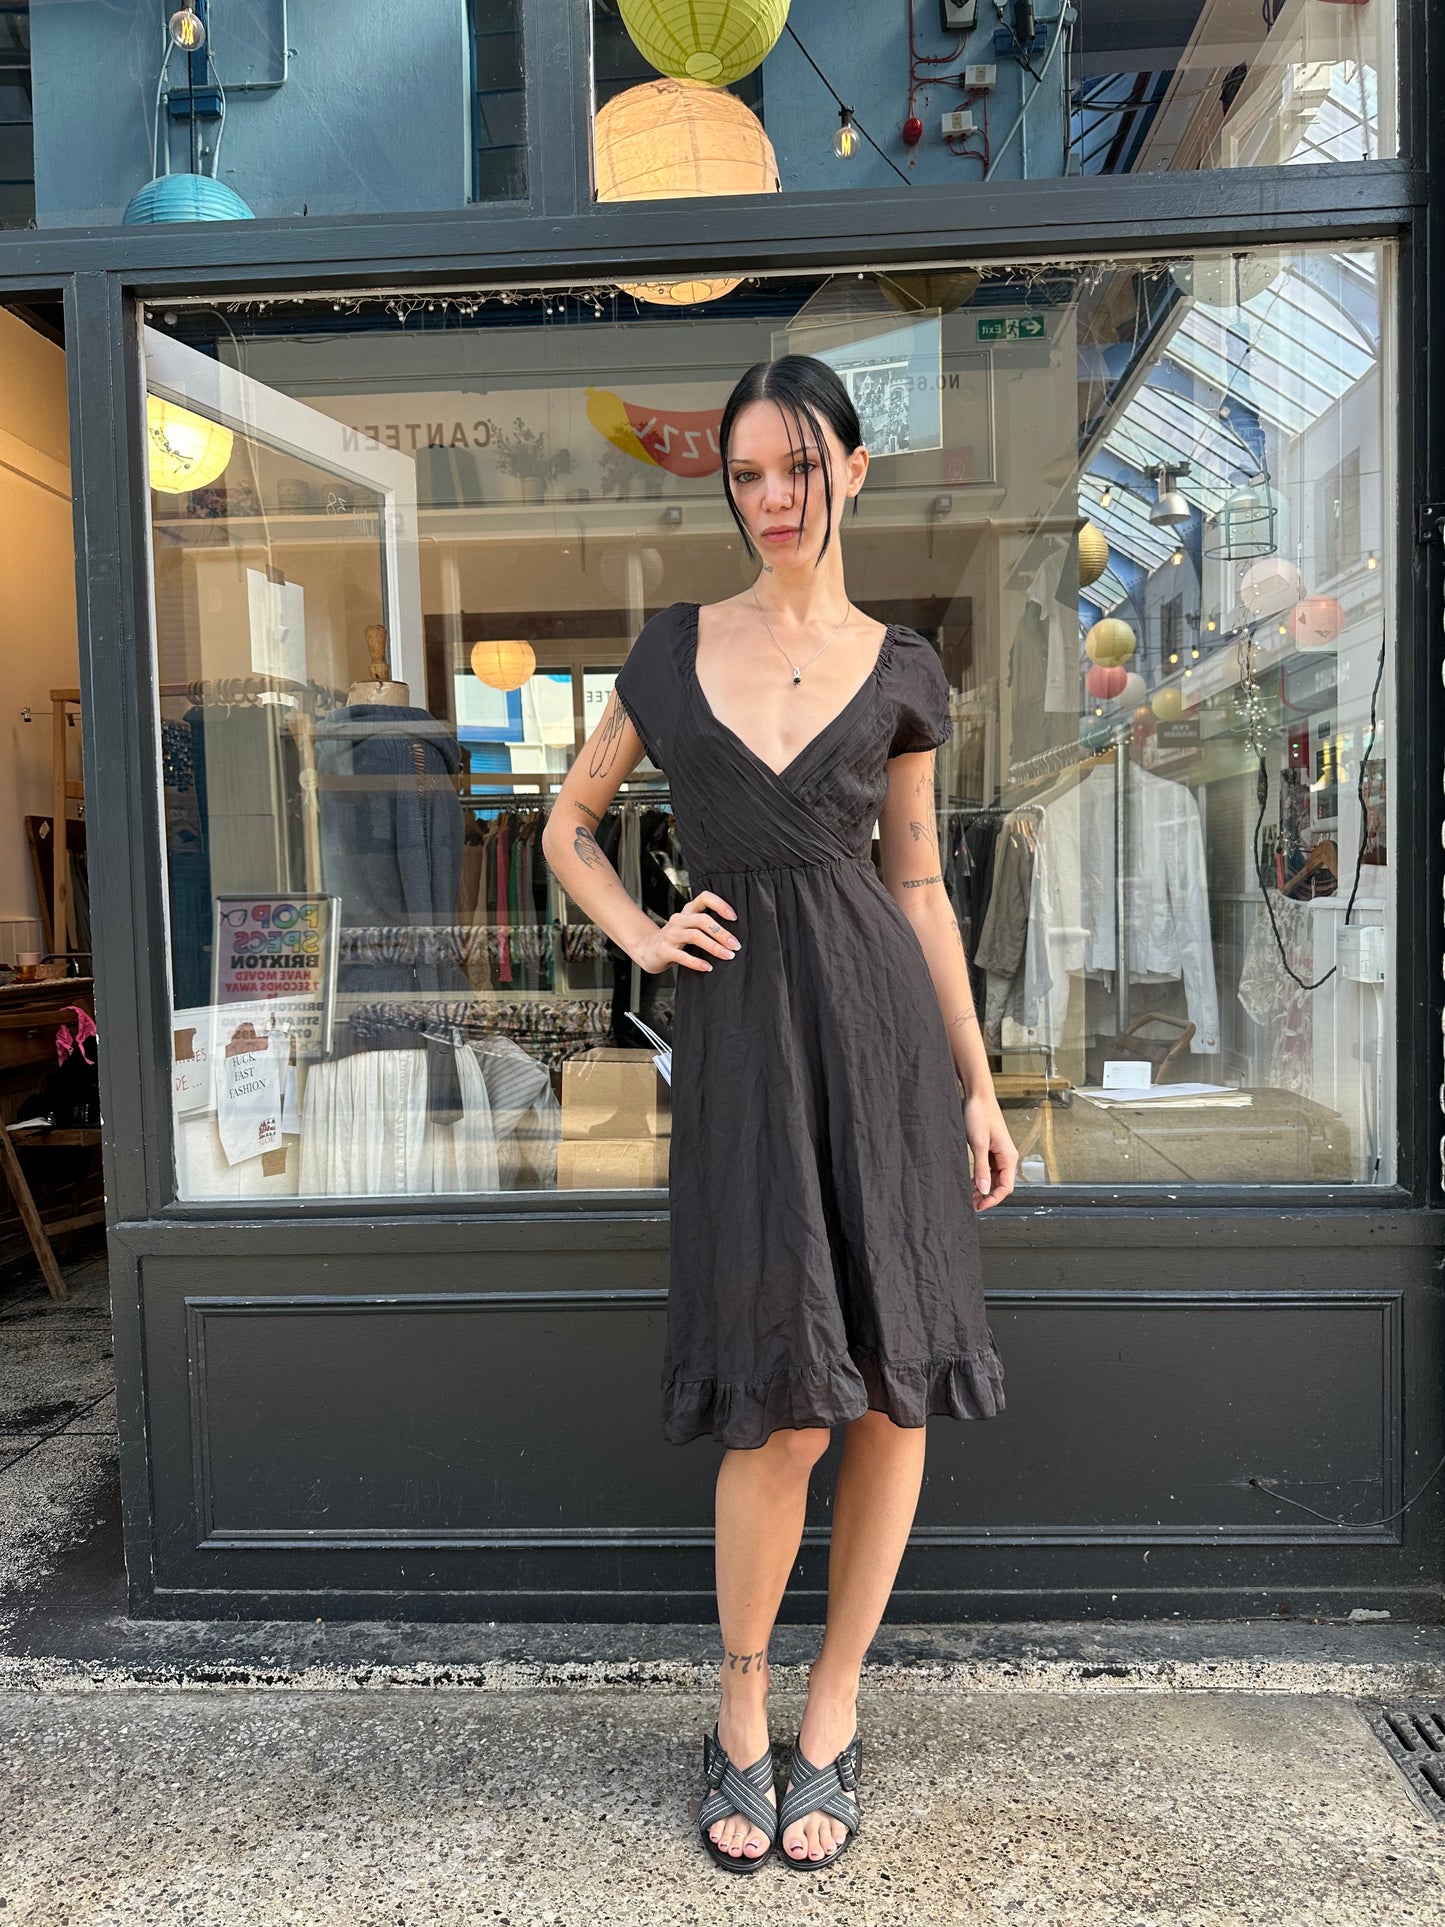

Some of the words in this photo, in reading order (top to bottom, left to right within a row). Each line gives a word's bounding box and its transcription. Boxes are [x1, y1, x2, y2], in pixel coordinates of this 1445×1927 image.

[232, 1052, 257, 1067] FUCK
[234, 1066, 255, 1082] FAST
[229, 1078, 267, 1099] FASHION
[728, 1649, 764, 1675] 777
